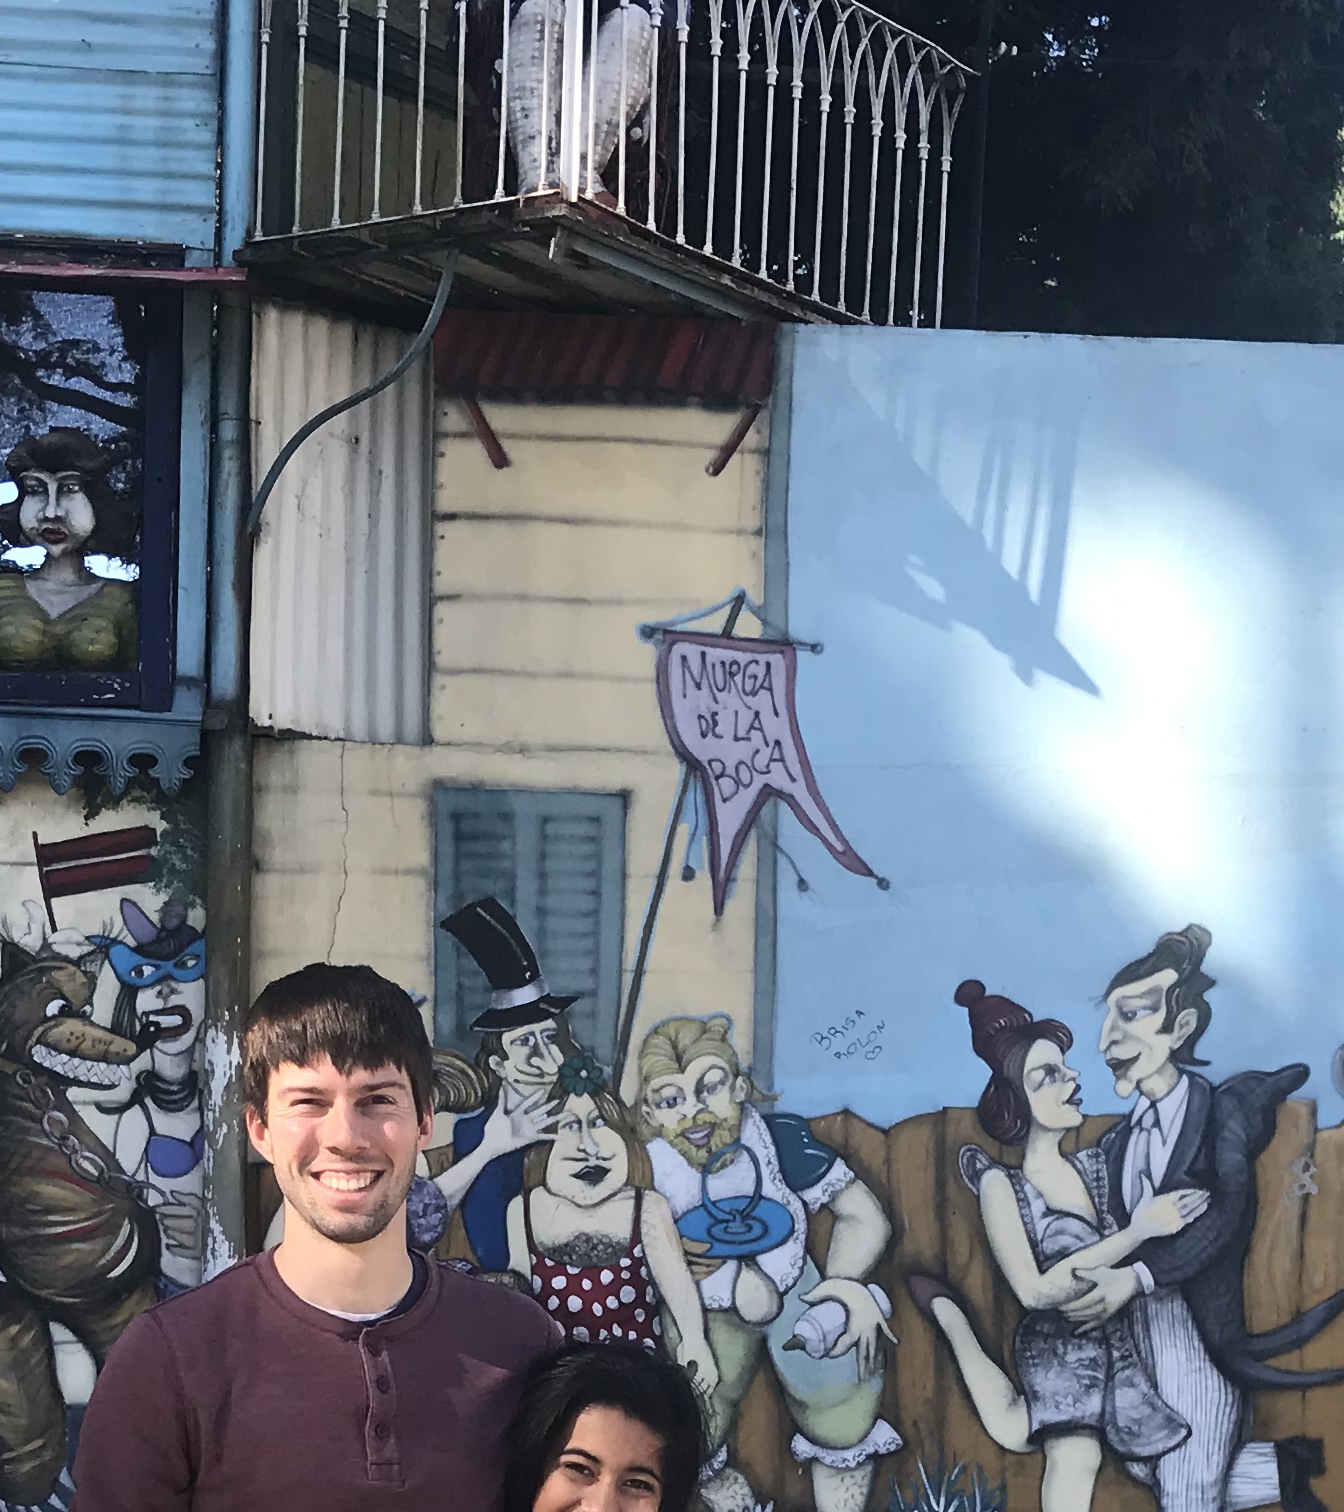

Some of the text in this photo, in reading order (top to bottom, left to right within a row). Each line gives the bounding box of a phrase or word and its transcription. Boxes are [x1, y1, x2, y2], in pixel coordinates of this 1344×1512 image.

[680, 650, 780, 719] MURGA
[696, 710, 770, 749] DE LA
[707, 739, 797, 804] BOCA
[809, 1009, 866, 1052] BRISA
[833, 1020, 885, 1060] ROLON
